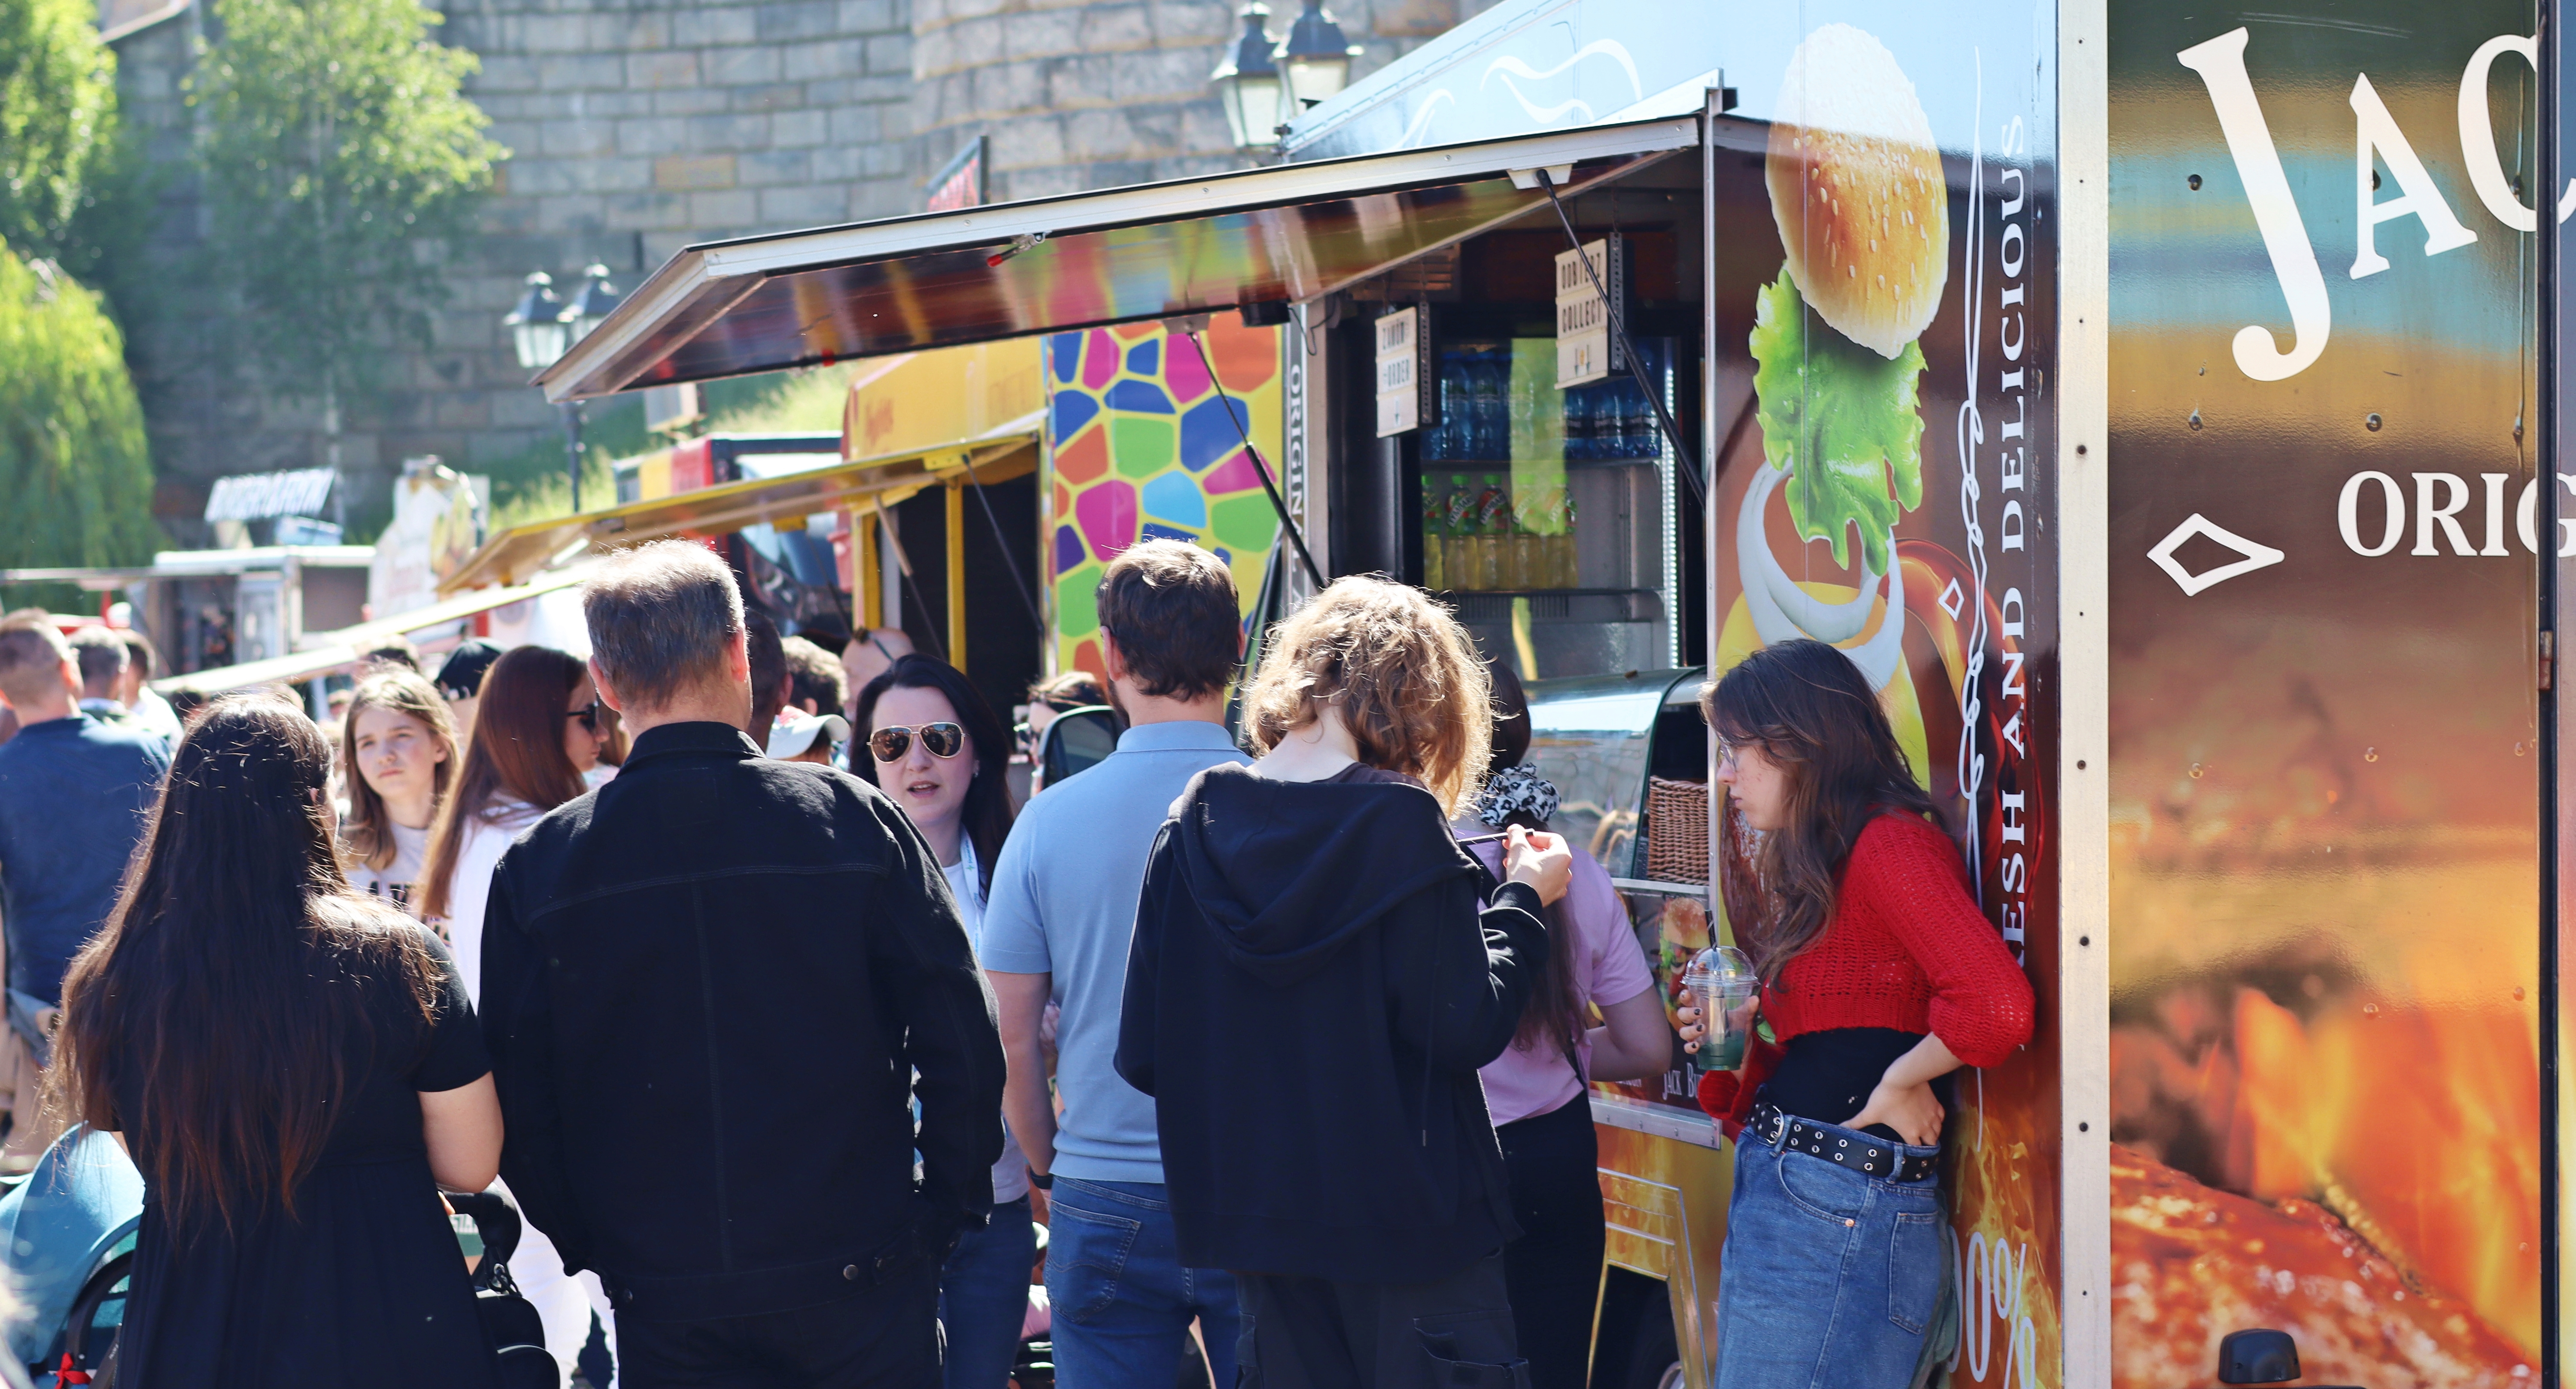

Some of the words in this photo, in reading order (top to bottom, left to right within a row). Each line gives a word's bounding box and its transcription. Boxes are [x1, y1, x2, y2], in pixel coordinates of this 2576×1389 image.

[1562, 297, 1601, 333] COLLECT
[2001, 115, 2025, 553] DELICIOUS
[2002, 587, 2025, 760] AND
[2002, 790, 2025, 968] ESH
